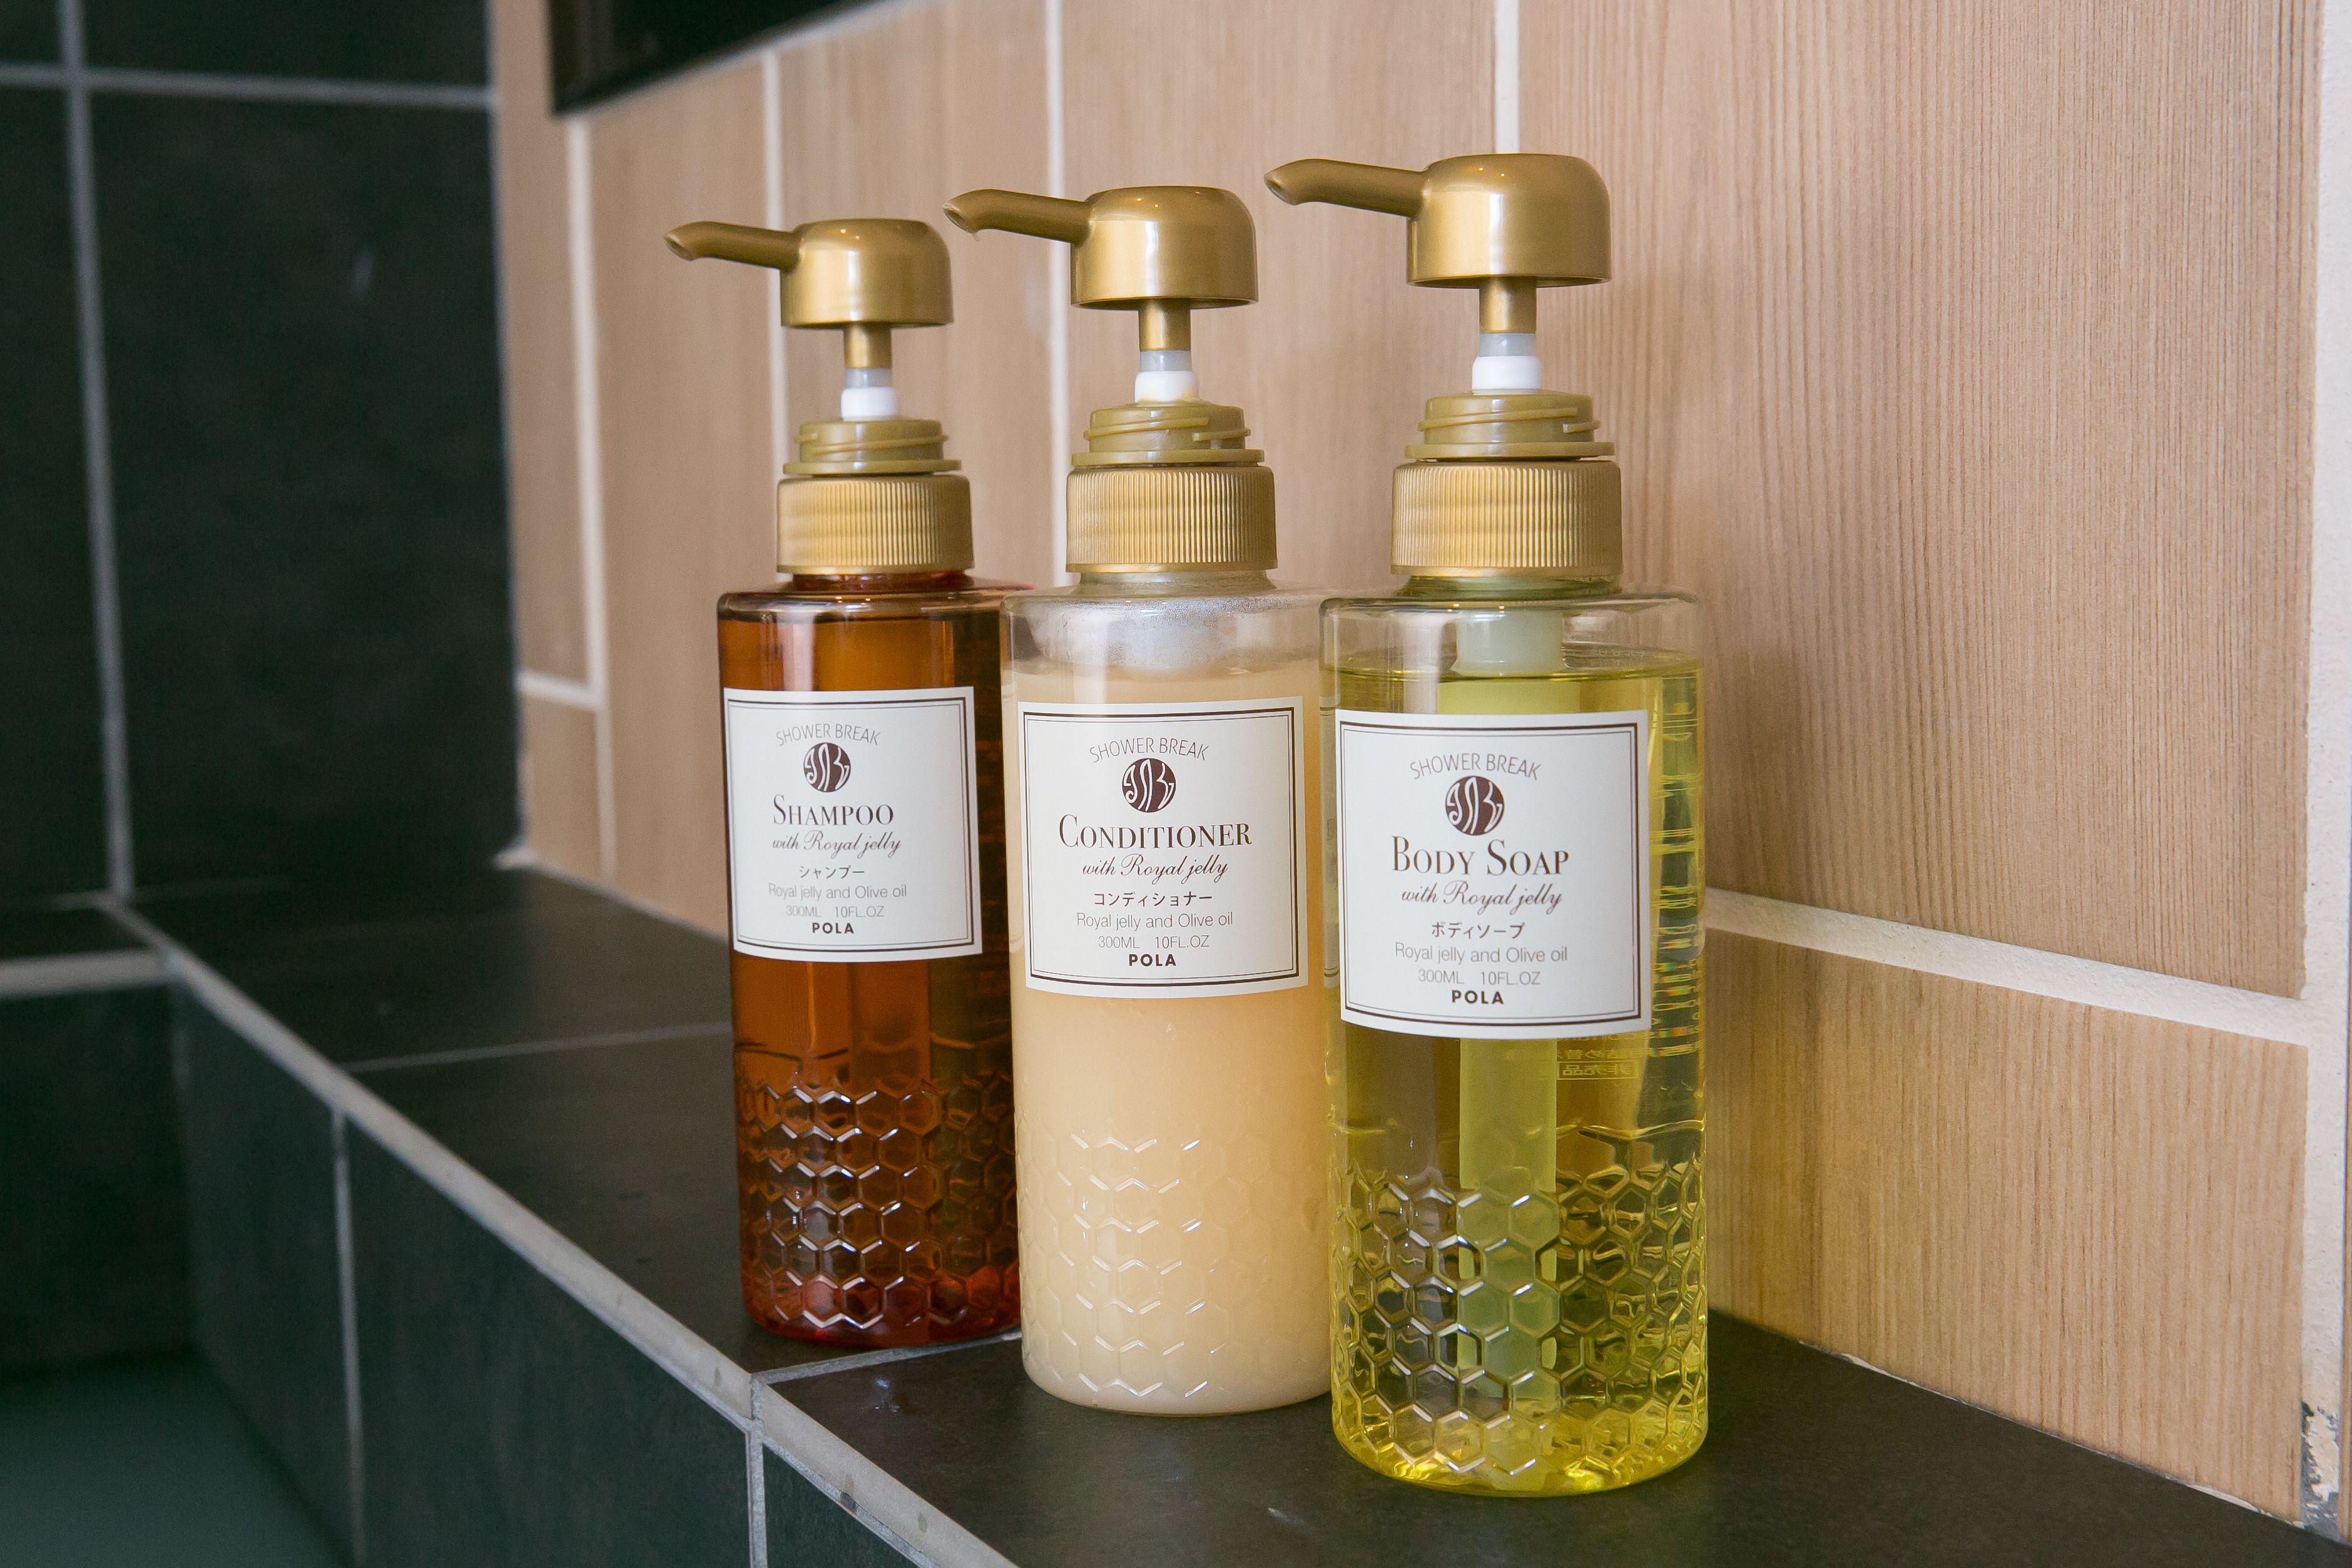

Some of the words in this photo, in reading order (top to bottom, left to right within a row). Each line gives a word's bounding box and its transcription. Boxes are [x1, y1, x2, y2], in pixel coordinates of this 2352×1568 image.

[776, 723, 831, 746] SHOWER
[835, 723, 880, 746] BREAK
[1089, 737, 1154, 763] SHOWER
[1160, 737, 1209, 761] BREAK
[1410, 753, 1481, 780] SHOWER
[1486, 754, 1542, 781] BREAK
[772, 832, 799, 850] with
[803, 830, 863, 858] Royal
[857, 832, 901, 858] jelly
[799, 865, 865, 879] シャンプー
[1082, 857, 1116, 876] with
[1121, 853, 1188, 885] Royal
[1181, 854, 1228, 884] jelly
[768, 883, 797, 899] Royal
[800, 885, 822, 901] jelly
[826, 886, 850, 899] and
[855, 885, 887, 899] Olive
[893, 884, 907, 897] oil
[1094, 890, 1213, 907] コンディショナー
[1402, 882, 1438, 904] with
[1443, 880, 1517, 915] Royal
[1509, 883, 1563, 915] jelly
[786, 905, 822, 917] 300ML
[835, 906, 884, 918] 10FL.OZ
[812, 922, 854, 934] POLA
[1077, 912, 1111, 930] Royal
[1115, 914, 1141, 931] jelly
[1146, 914, 1173, 928] and
[1178, 913, 1213, 927] Olive
[1218, 912, 1233, 925] oil
[1432, 921, 1525, 939] ボディソープ
[1098, 936, 1140, 949] 300ML
[1154, 935, 1209, 949] 10FL.OZ
[1129, 954, 1176, 967] POLA
[1395, 942, 1433, 961] Royal
[1438, 945, 1465, 964] jelly
[1470, 947, 1500, 963] and
[1506, 947, 1545, 963] Olive
[1550, 947, 1567, 962] oil
[1418, 969, 1465, 984] 300ML
[1480, 971, 1541, 985] 10FL.OZ
[1452, 990, 1504, 1005] POLA
